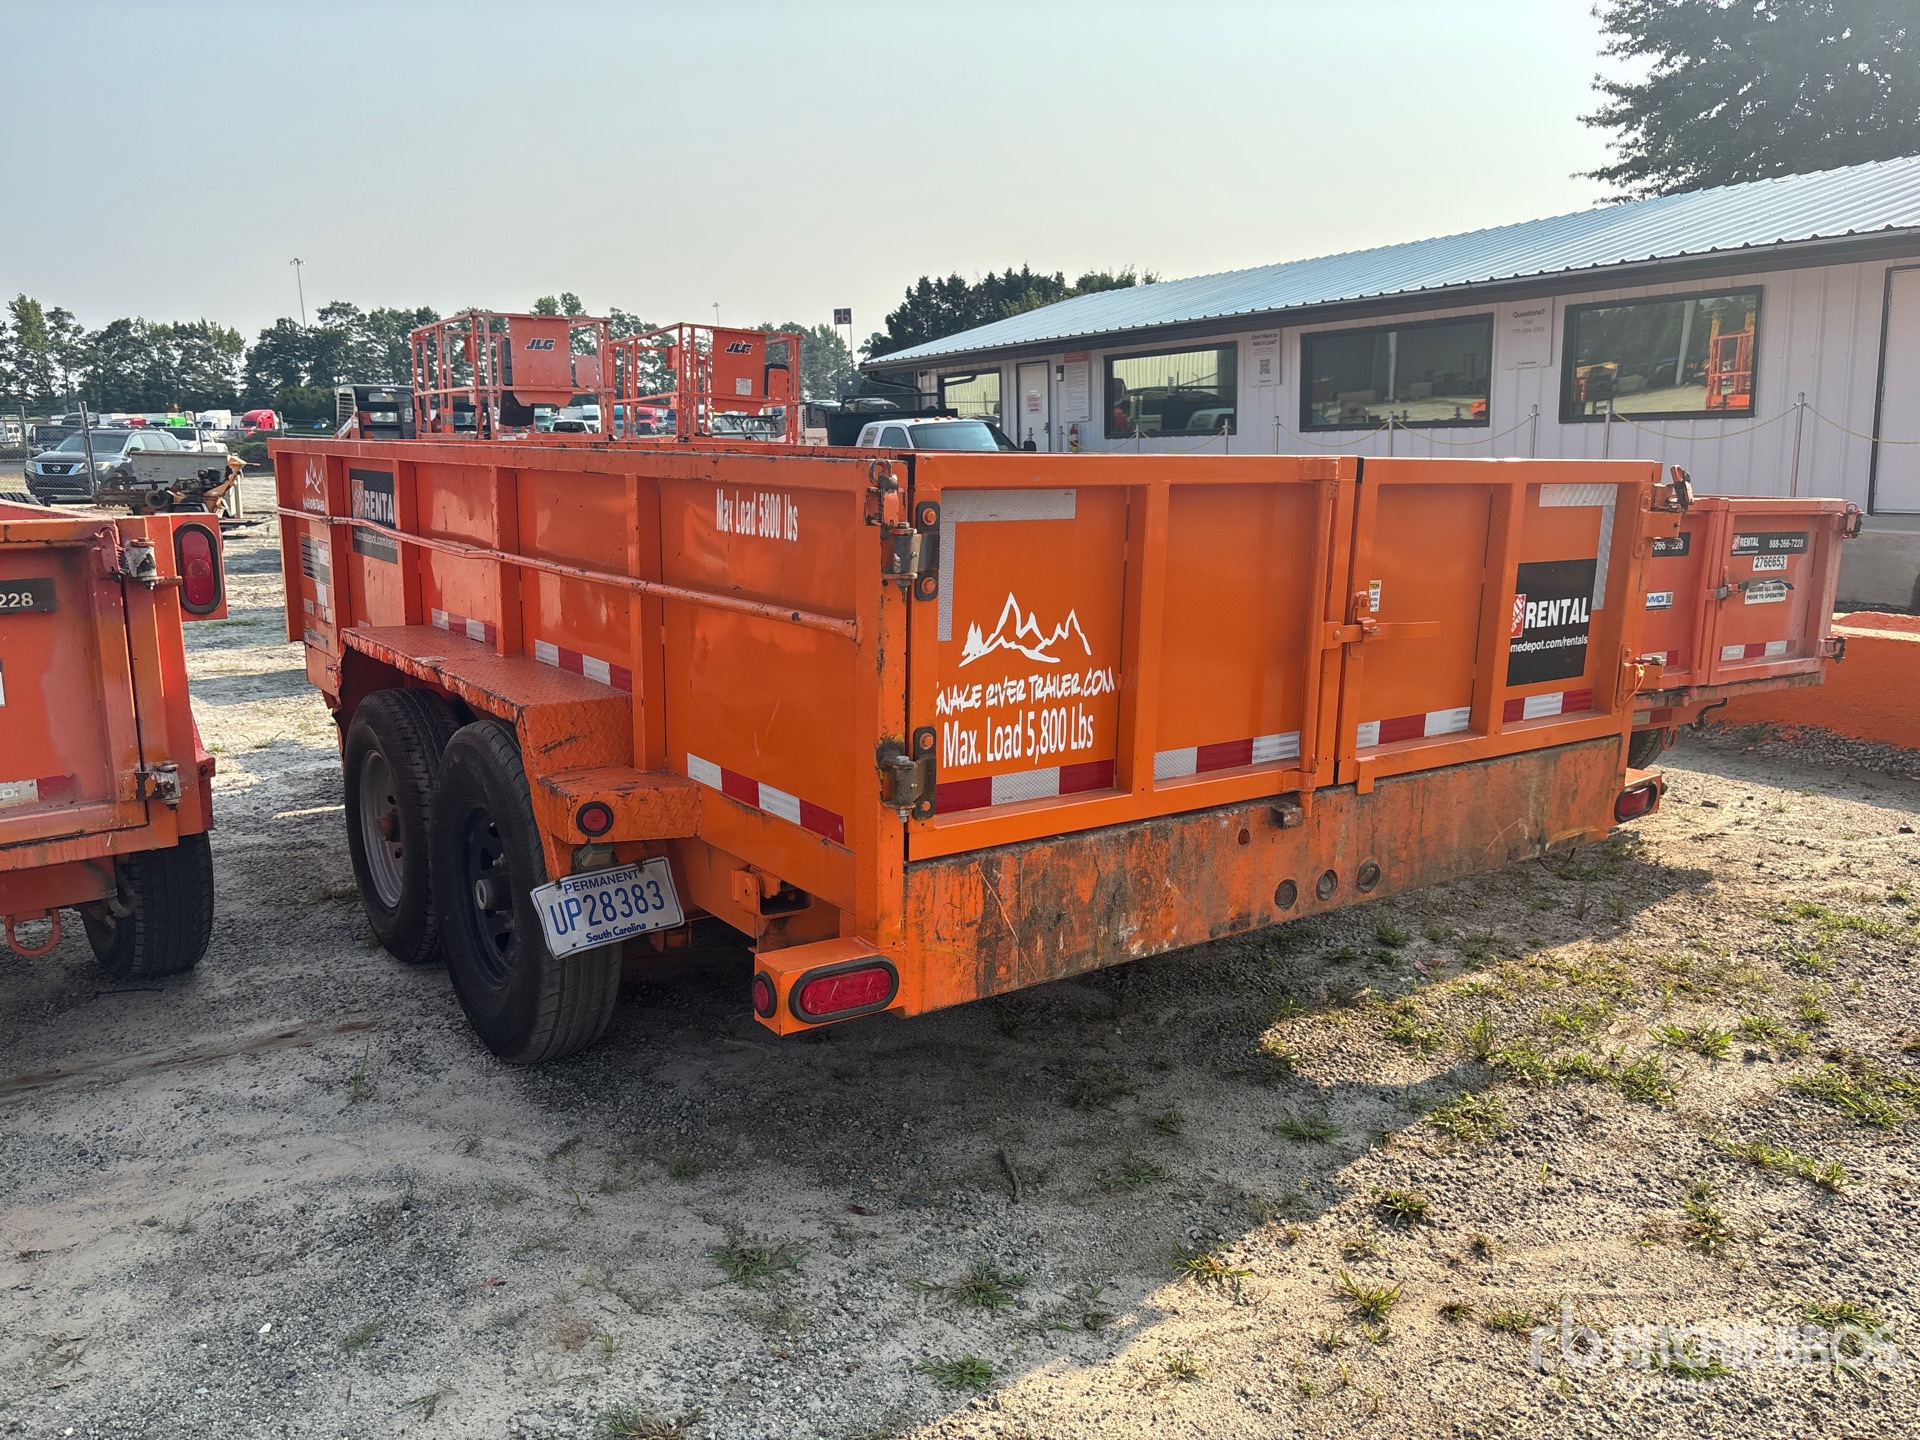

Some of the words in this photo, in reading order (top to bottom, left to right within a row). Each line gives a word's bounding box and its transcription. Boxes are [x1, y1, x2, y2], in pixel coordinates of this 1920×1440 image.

[1513, 308, 1545, 319] Questions?
[525, 338, 555, 351] JLG
[364, 490, 396, 524] RENTA
[716, 488, 733, 533] Max
[736, 490, 756, 536] Load
[759, 492, 781, 539] 5800
[783, 494, 798, 542] lbs
[1739, 537, 1760, 547] RENTAL
[1769, 539, 1804, 549] 888-266-7228
[1754, 556, 1786, 568] 2766653
[1524, 597, 1589, 629] RENTAL
[986, 675, 1026, 708] RIVER
[1028, 666, 1115, 704] TRAILER.COM
[943, 720, 981, 768] Max.
[986, 709, 1022, 762] Load
[1026, 706, 1067, 764] 5,800
[1071, 702, 1094, 750] Lbs
[563, 869, 639, 894] PERMANENT
[550, 880, 665, 936] UP28383
[586, 928, 612, 943] South
[612, 922, 647, 936] Carolina
